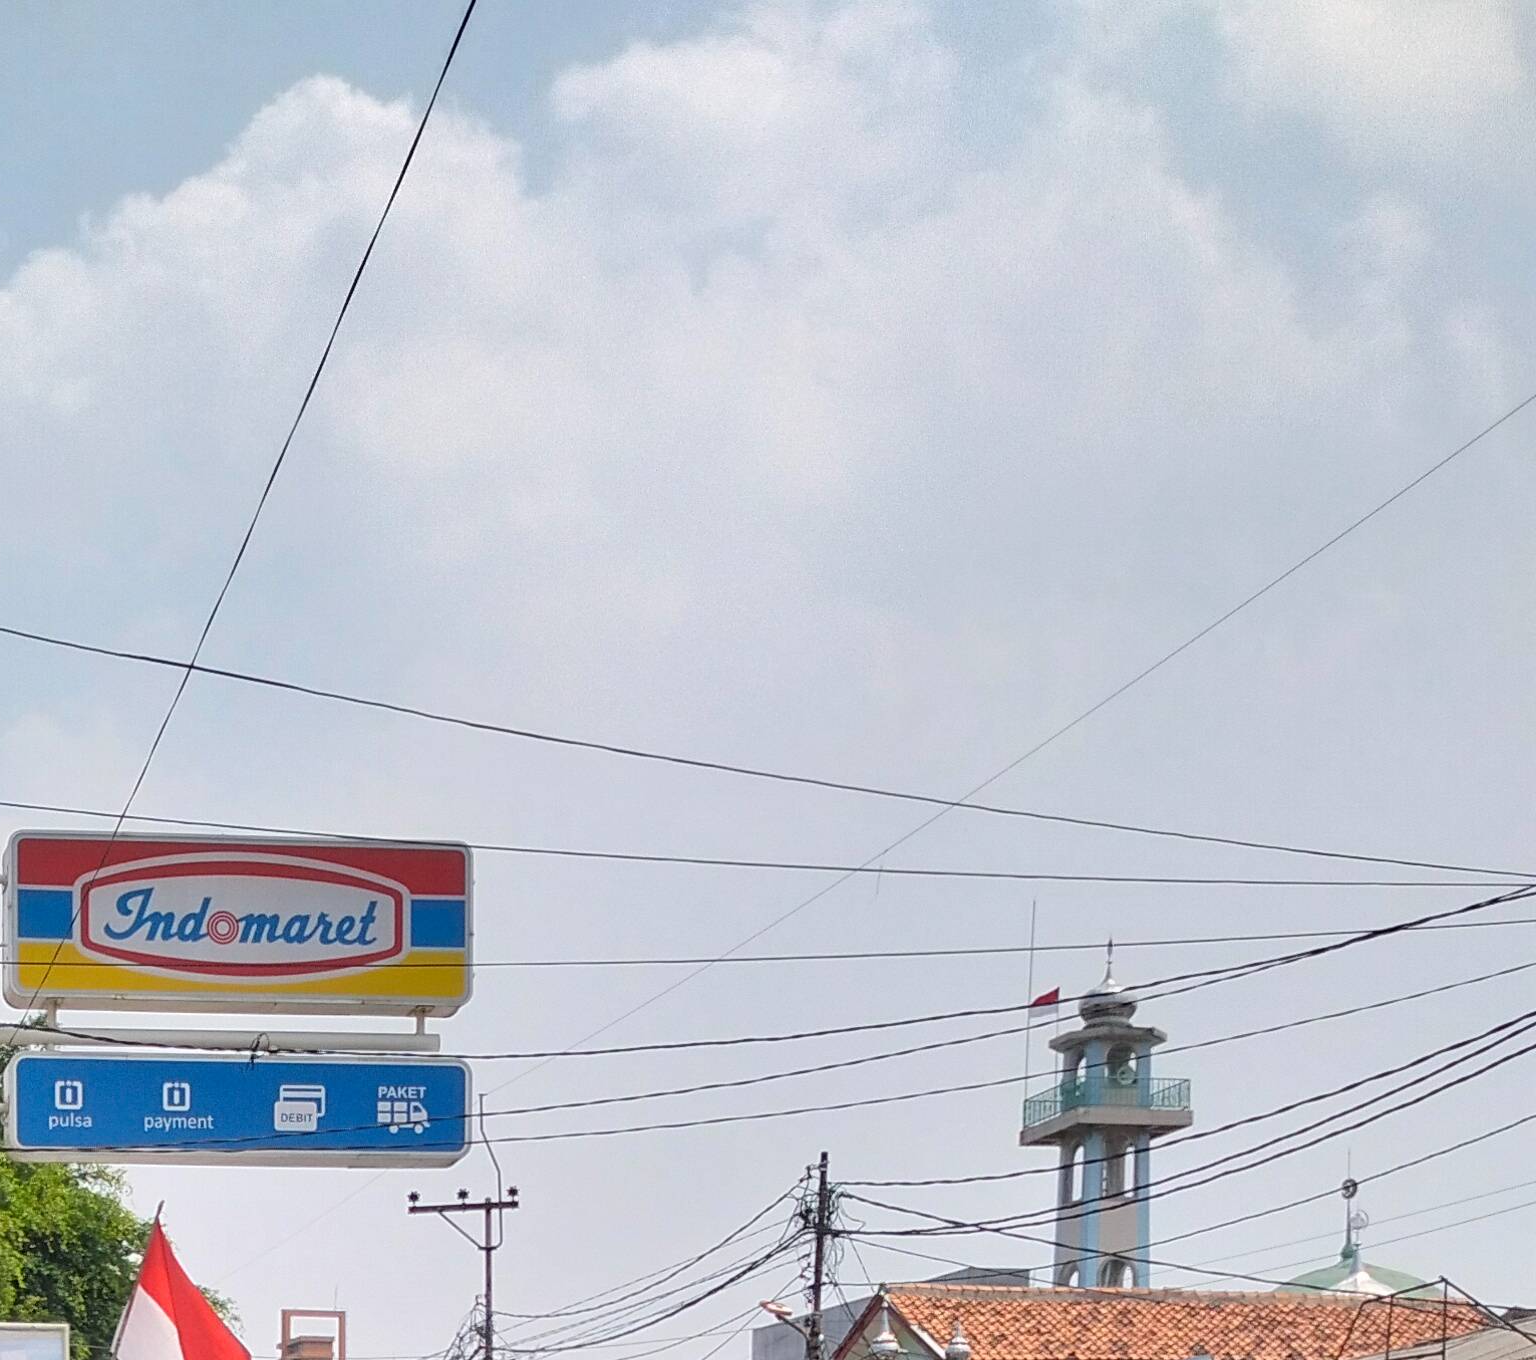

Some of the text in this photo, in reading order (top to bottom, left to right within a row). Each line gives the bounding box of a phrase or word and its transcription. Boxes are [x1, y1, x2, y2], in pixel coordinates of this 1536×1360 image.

[103, 887, 378, 945] Indomaret
[378, 1086, 427, 1099] PAKET
[48, 1113, 93, 1131] pulsa
[144, 1115, 214, 1134] payment
[280, 1112, 314, 1125] DEBIT
